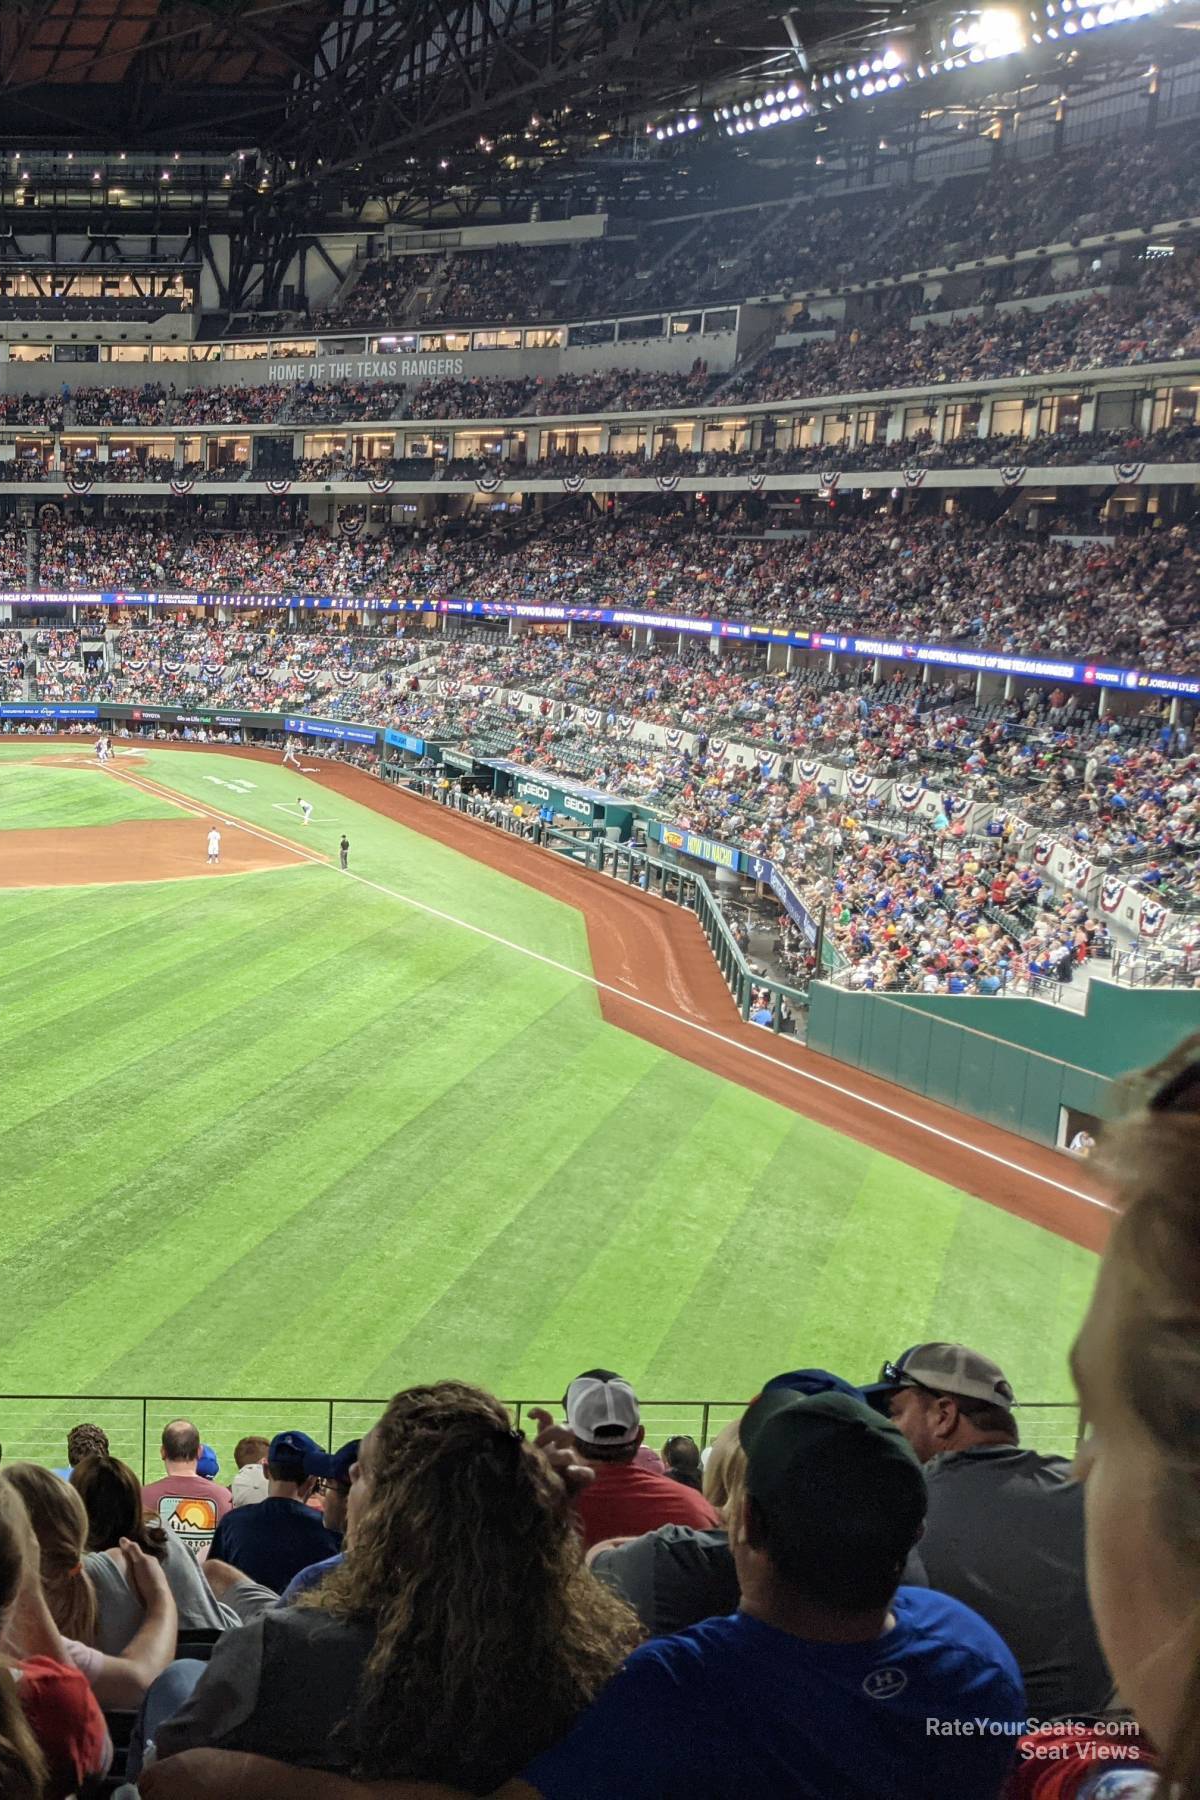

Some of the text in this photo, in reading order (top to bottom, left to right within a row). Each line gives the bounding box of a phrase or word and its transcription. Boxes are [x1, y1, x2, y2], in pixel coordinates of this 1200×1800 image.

[268, 358, 464, 381] HOME OF THE TEXAS RANGERS
[20, 594, 32, 602] OF
[32, 594, 45, 602] THE
[45, 594, 67, 602] TEXAS
[68, 594, 102, 602] RANGERS
[516, 606, 565, 617] TOYOTA RAV4
[854, 640, 903, 657] TOYOTA RAV4
[916, 649, 1074, 678] AN OFFICIAL VEHICLE OF THE TEXAS RANGERS
[1095, 672, 1119, 682] TOYOTA
[1148, 679, 1178, 690] JORDAN
[1178, 682, 1200, 692] LYLES
[40, 707, 56, 716] Kroger
[142, 712, 160, 720] TOYOTA
[526, 784, 550, 801] GEICO
[564, 796, 590, 815] GEICO
[688, 834, 702, 856] HOW
[703, 839, 710, 858] TO
